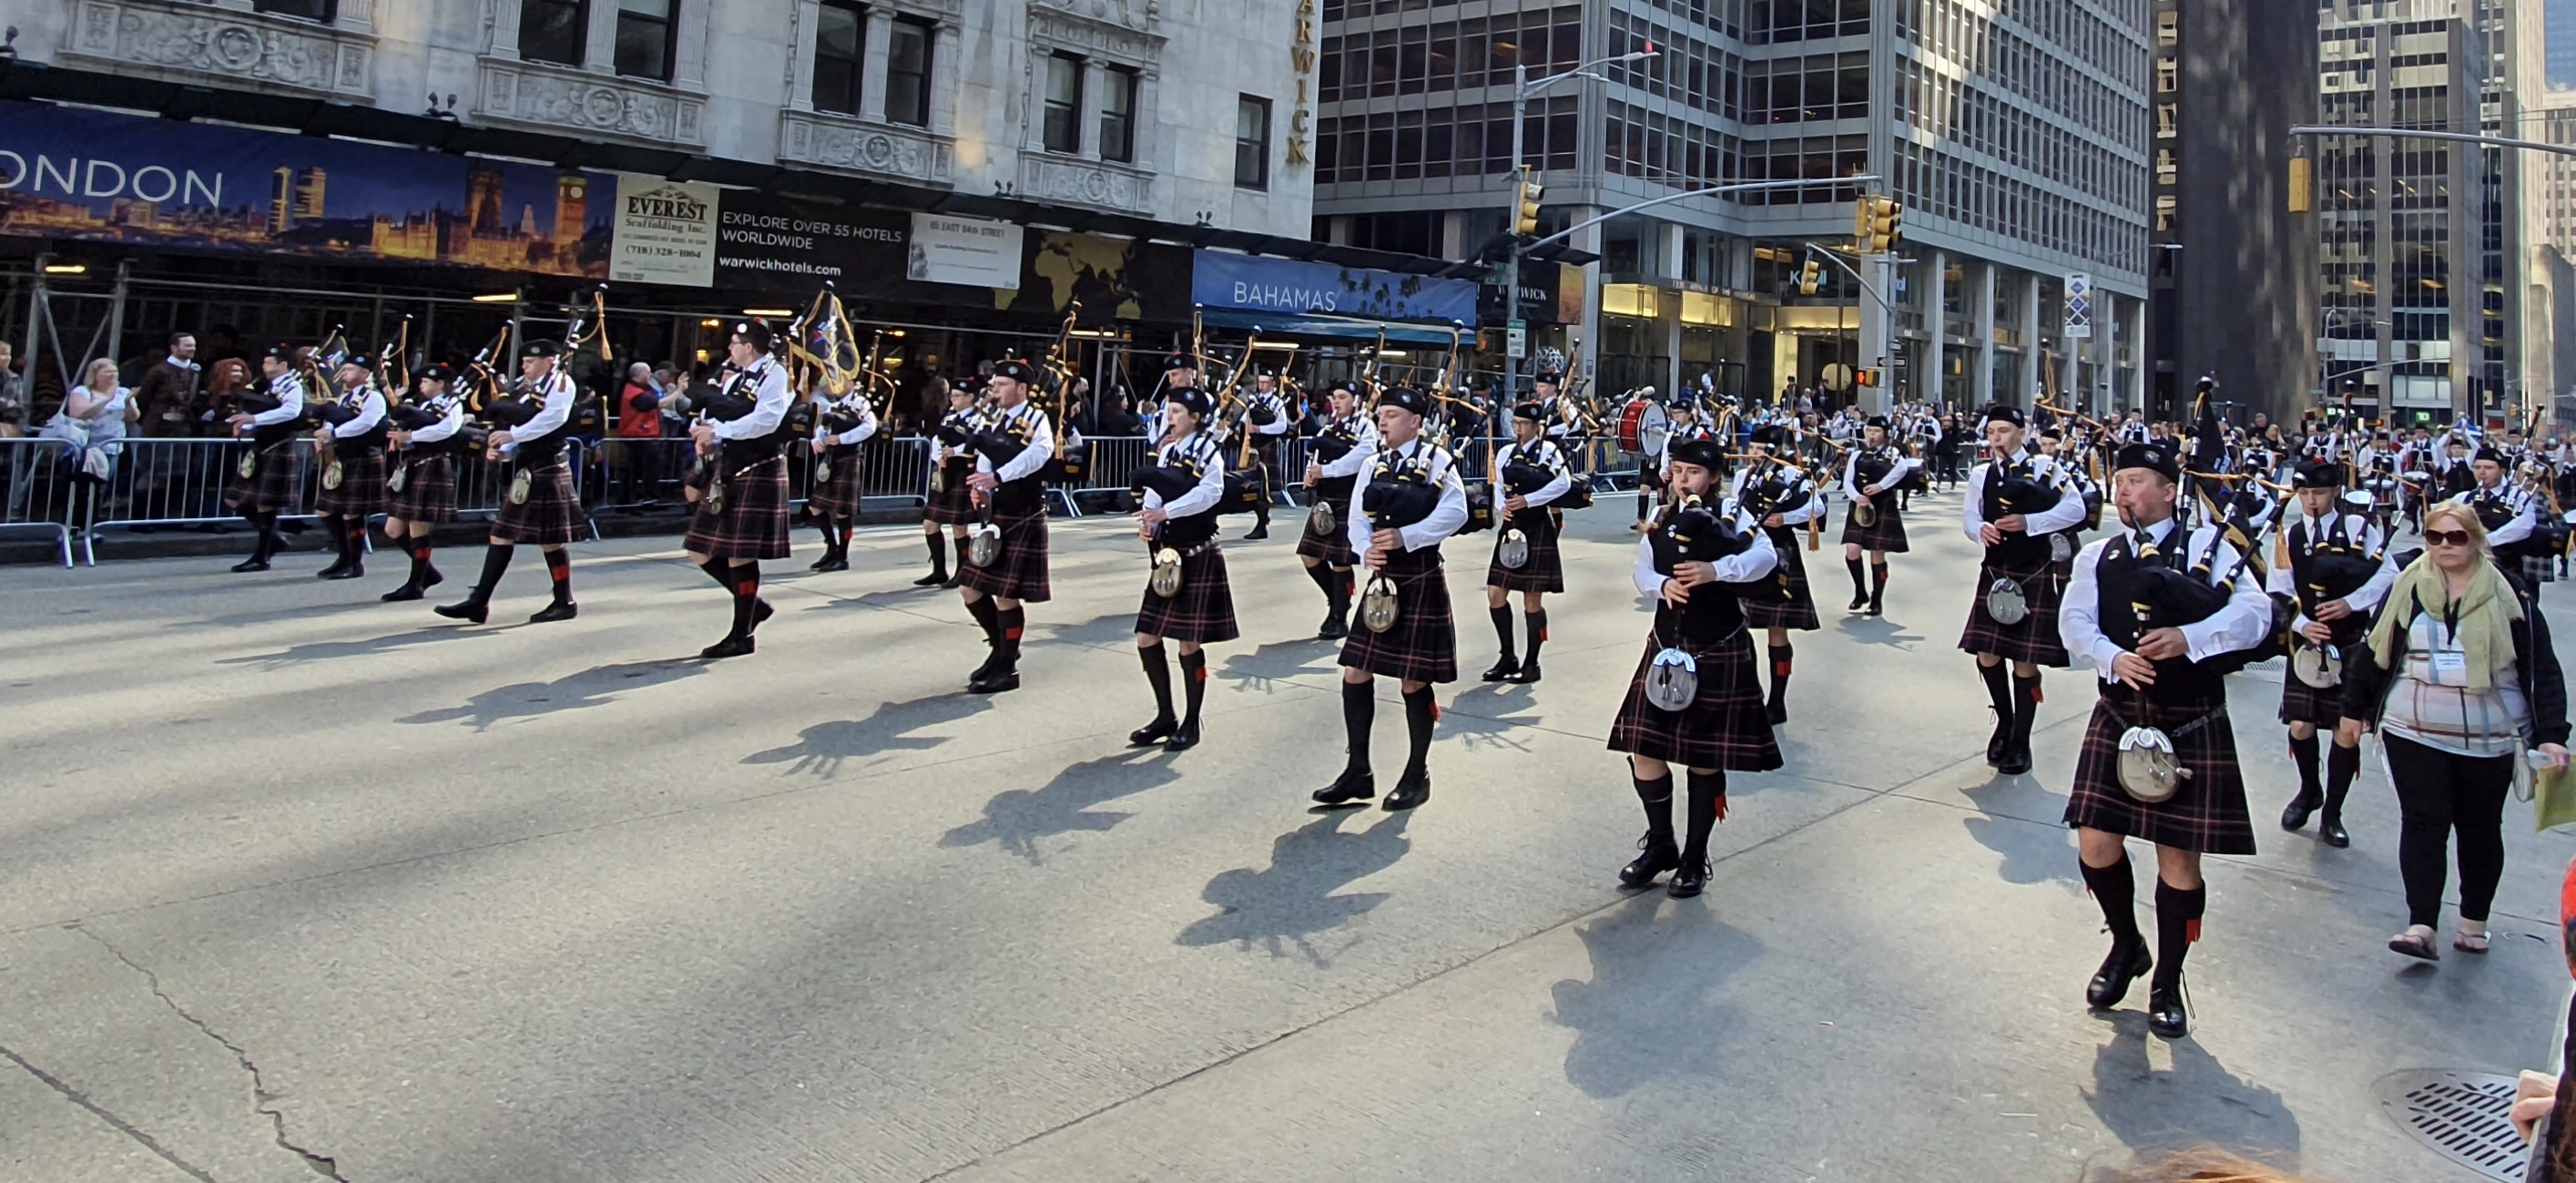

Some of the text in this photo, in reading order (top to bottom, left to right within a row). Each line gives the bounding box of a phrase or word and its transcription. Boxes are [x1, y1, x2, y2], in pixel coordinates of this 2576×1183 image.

[627, 196, 708, 220] EVEREST
[626, 218, 684, 234] Scaffolding
[723, 211, 902, 242] EXPLORE OVER 55 HOTELS
[722, 229, 814, 250] WORLDWIDE
[626, 245, 653, 255] (718)
[719, 257, 841, 276] warwickhotels.com
[1234, 280, 1336, 312] BAHAMAS
[1498, 285, 1547, 301] WWICK
